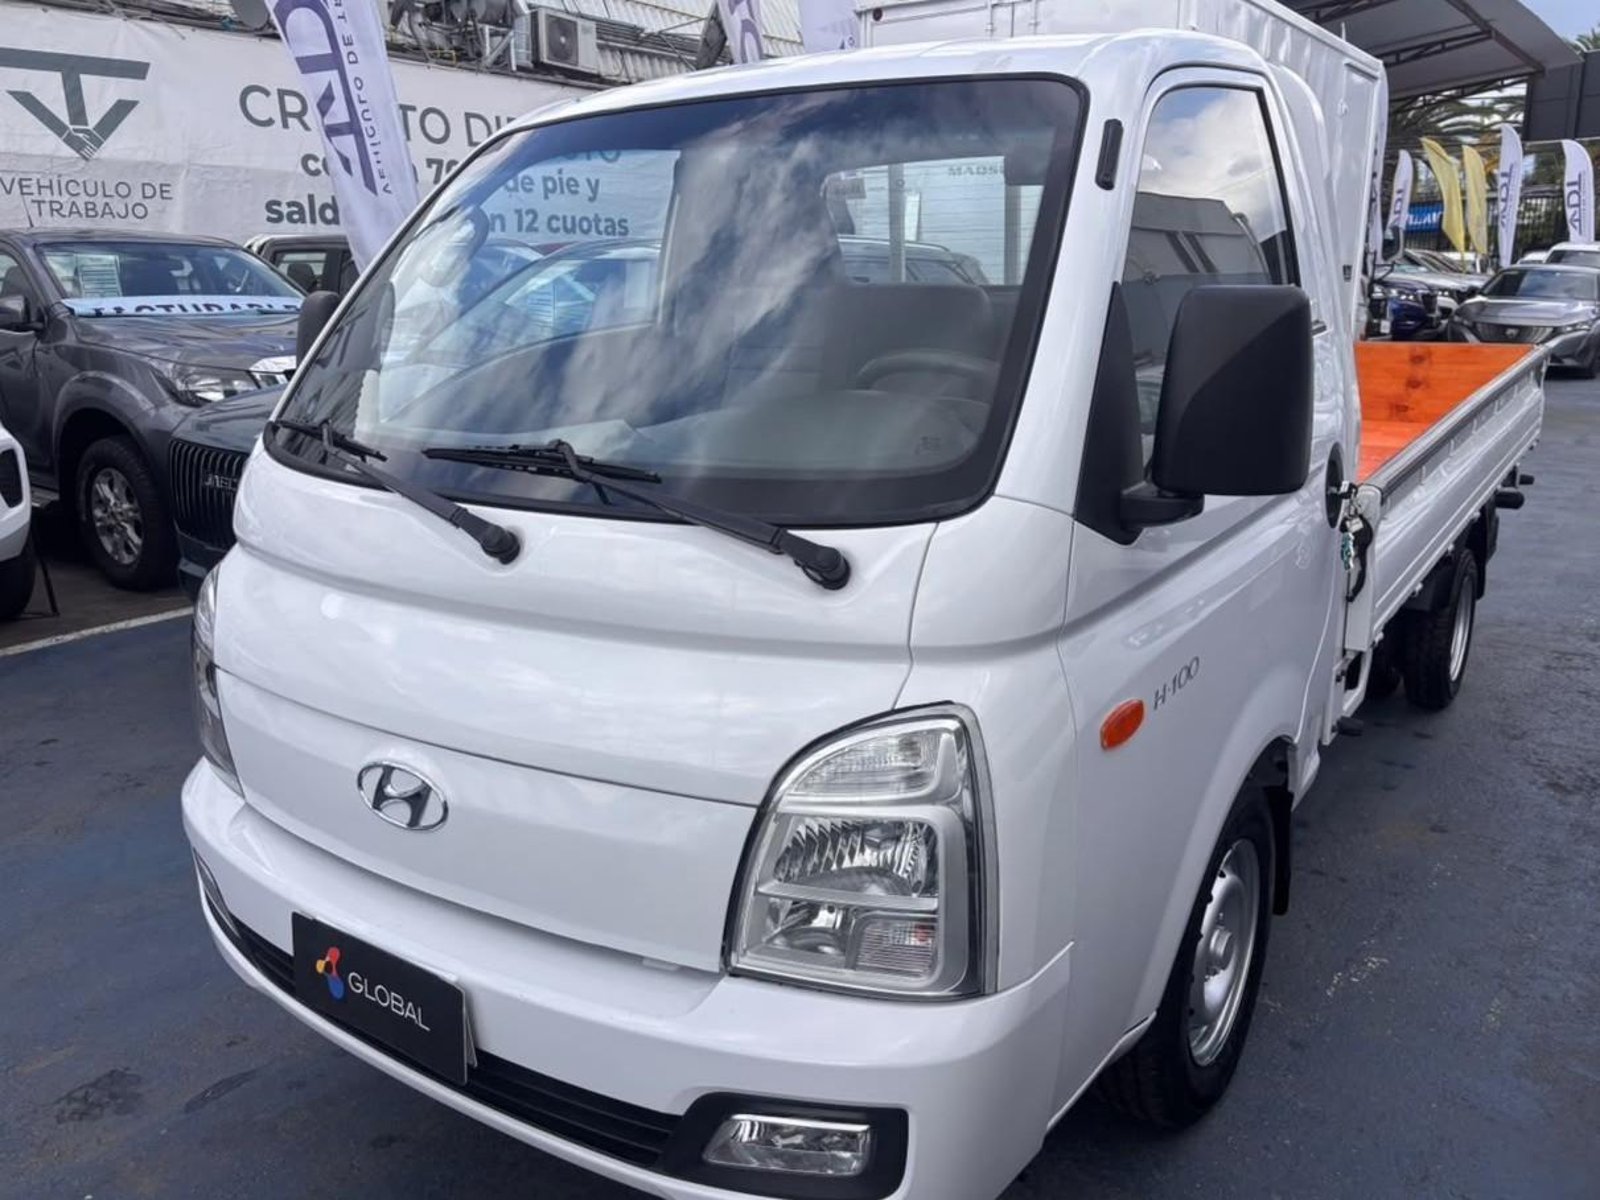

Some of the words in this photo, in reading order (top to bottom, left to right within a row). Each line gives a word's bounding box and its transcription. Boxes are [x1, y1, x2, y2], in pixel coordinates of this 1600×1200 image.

[0, 175, 132, 199] VEHÍCULO
[141, 182, 174, 200] DE
[542, 168, 580, 200] pie
[586, 176, 600, 203] y
[31, 200, 149, 220] TRABAJO
[514, 208, 539, 234] 12
[546, 213, 630, 237] cuotas
[348, 971, 431, 1032] GLOBAL
